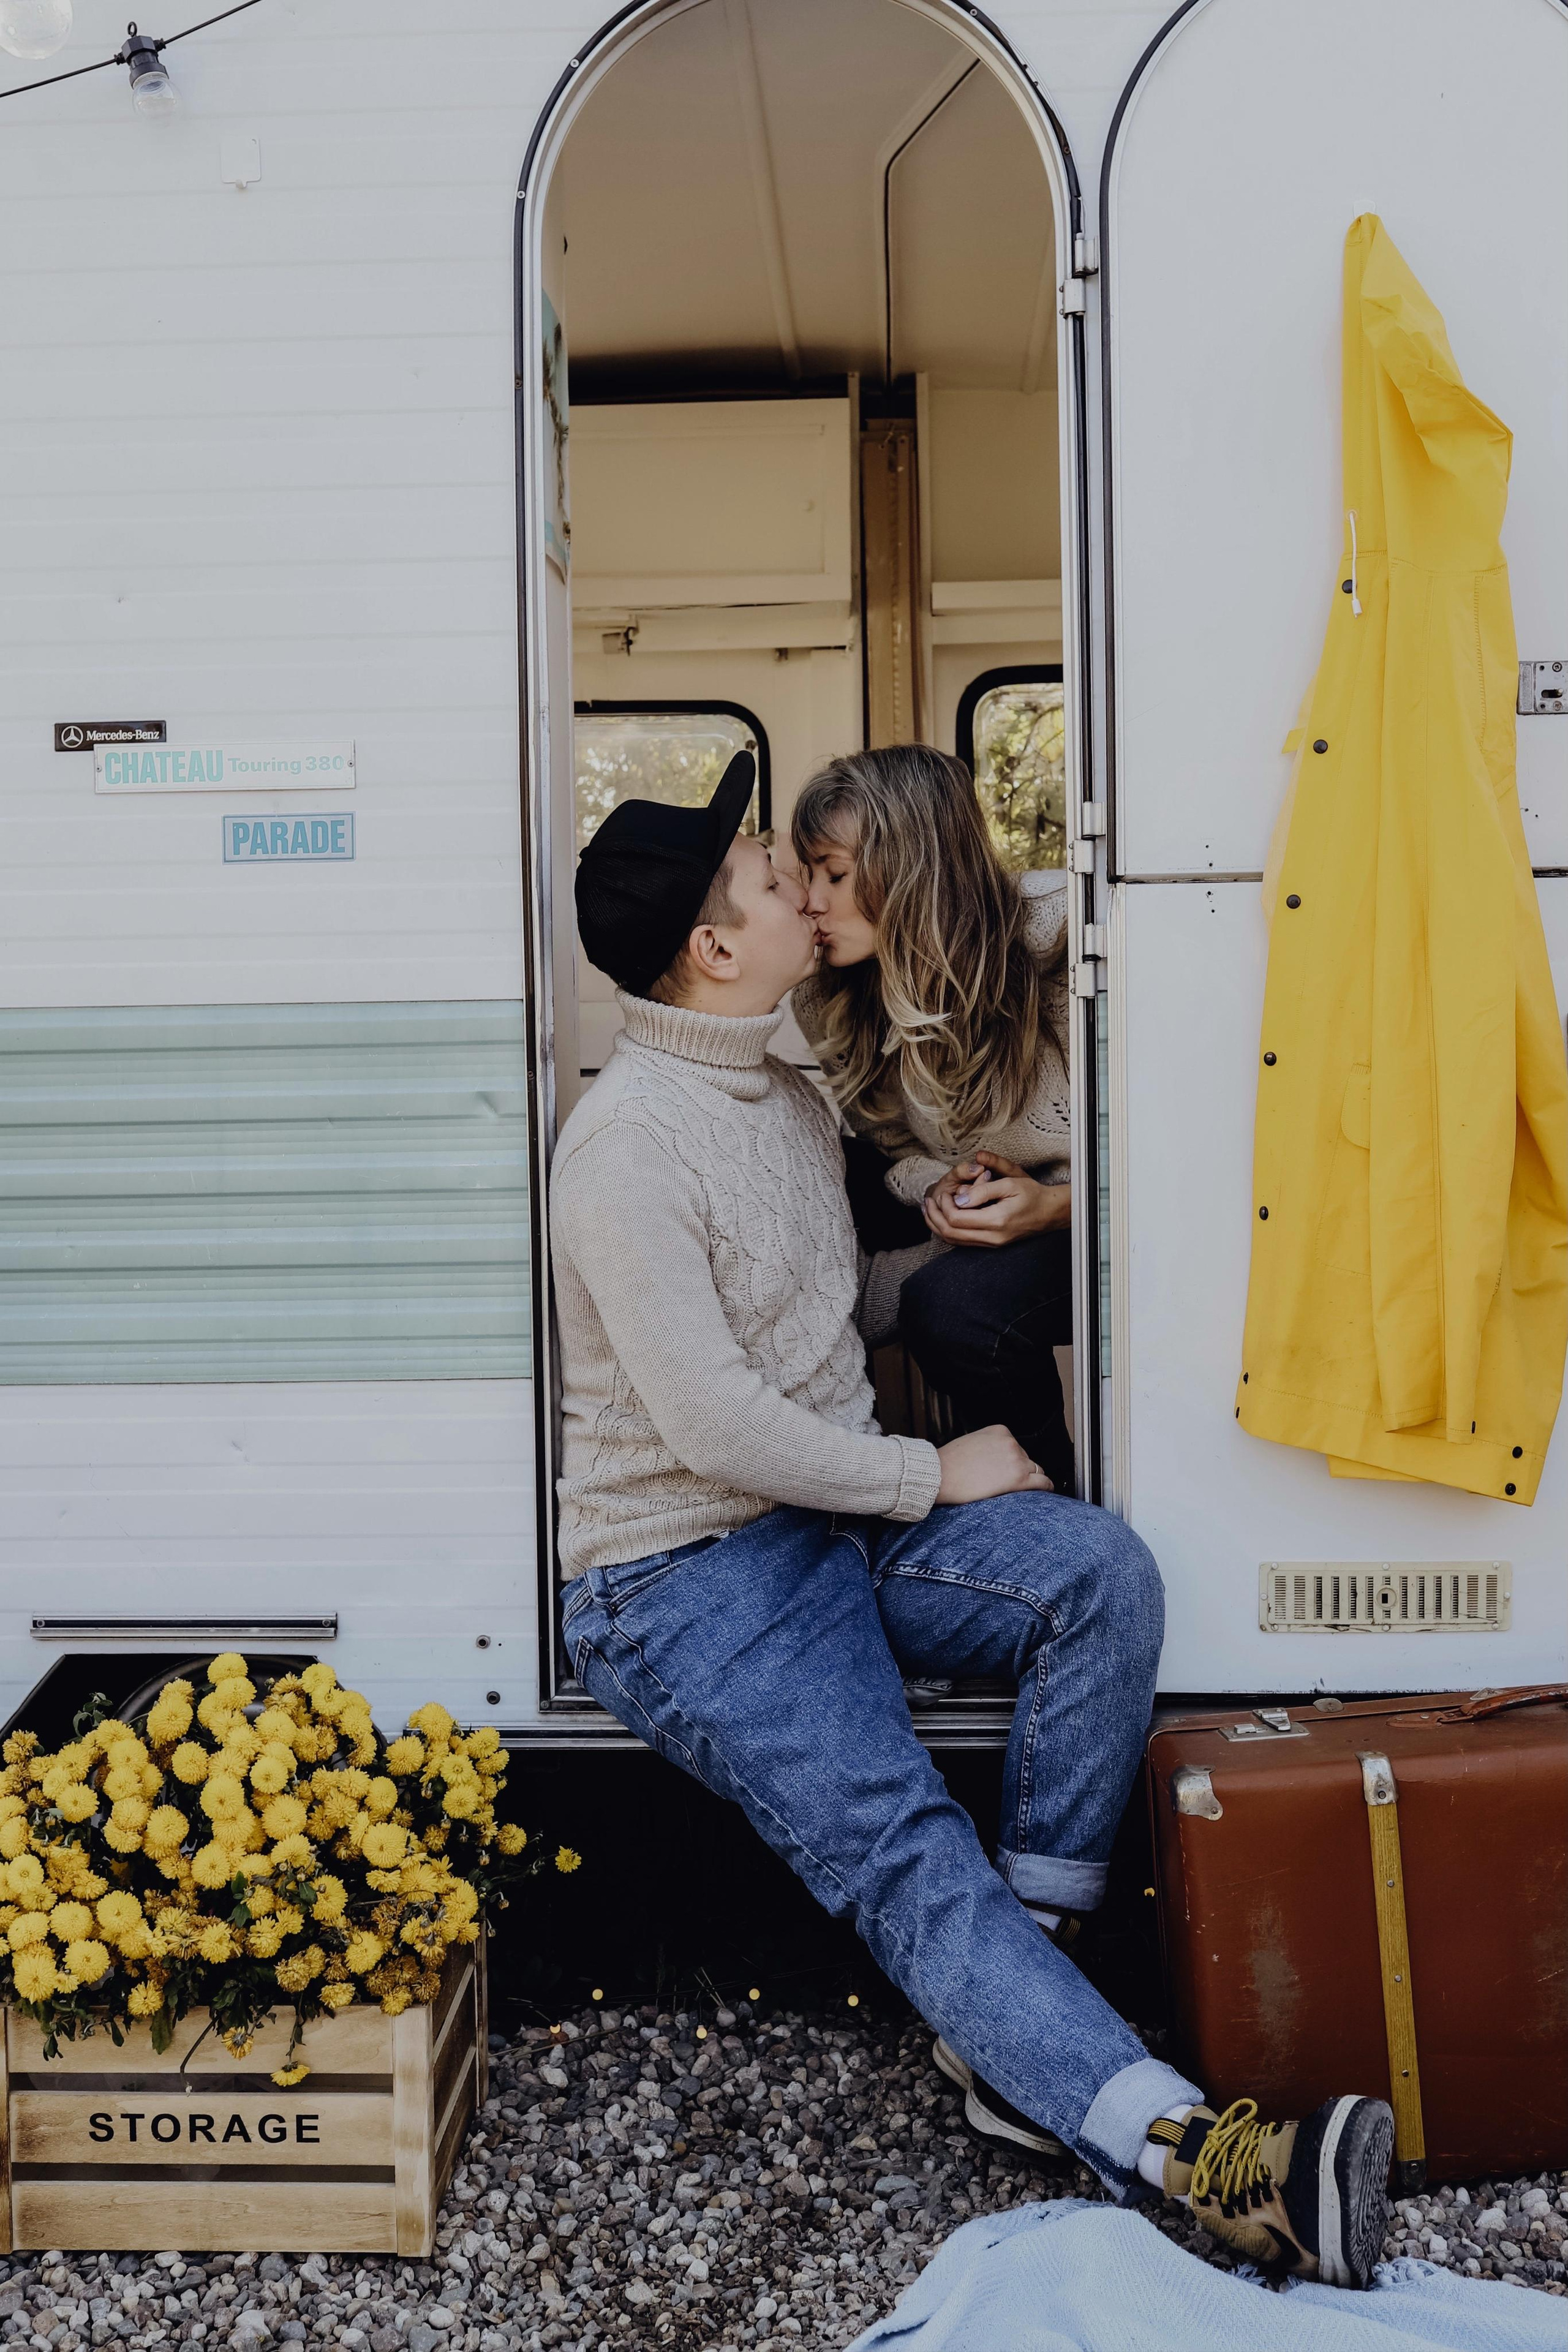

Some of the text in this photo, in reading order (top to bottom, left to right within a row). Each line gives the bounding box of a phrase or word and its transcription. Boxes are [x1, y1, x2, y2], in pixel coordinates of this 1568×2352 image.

[86, 729, 159, 742] Mercedes-Benz
[105, 750, 344, 785] CHATEAU Touring 380
[232, 820, 345, 855] PARADE
[88, 2112, 320, 2144] STORAGE
